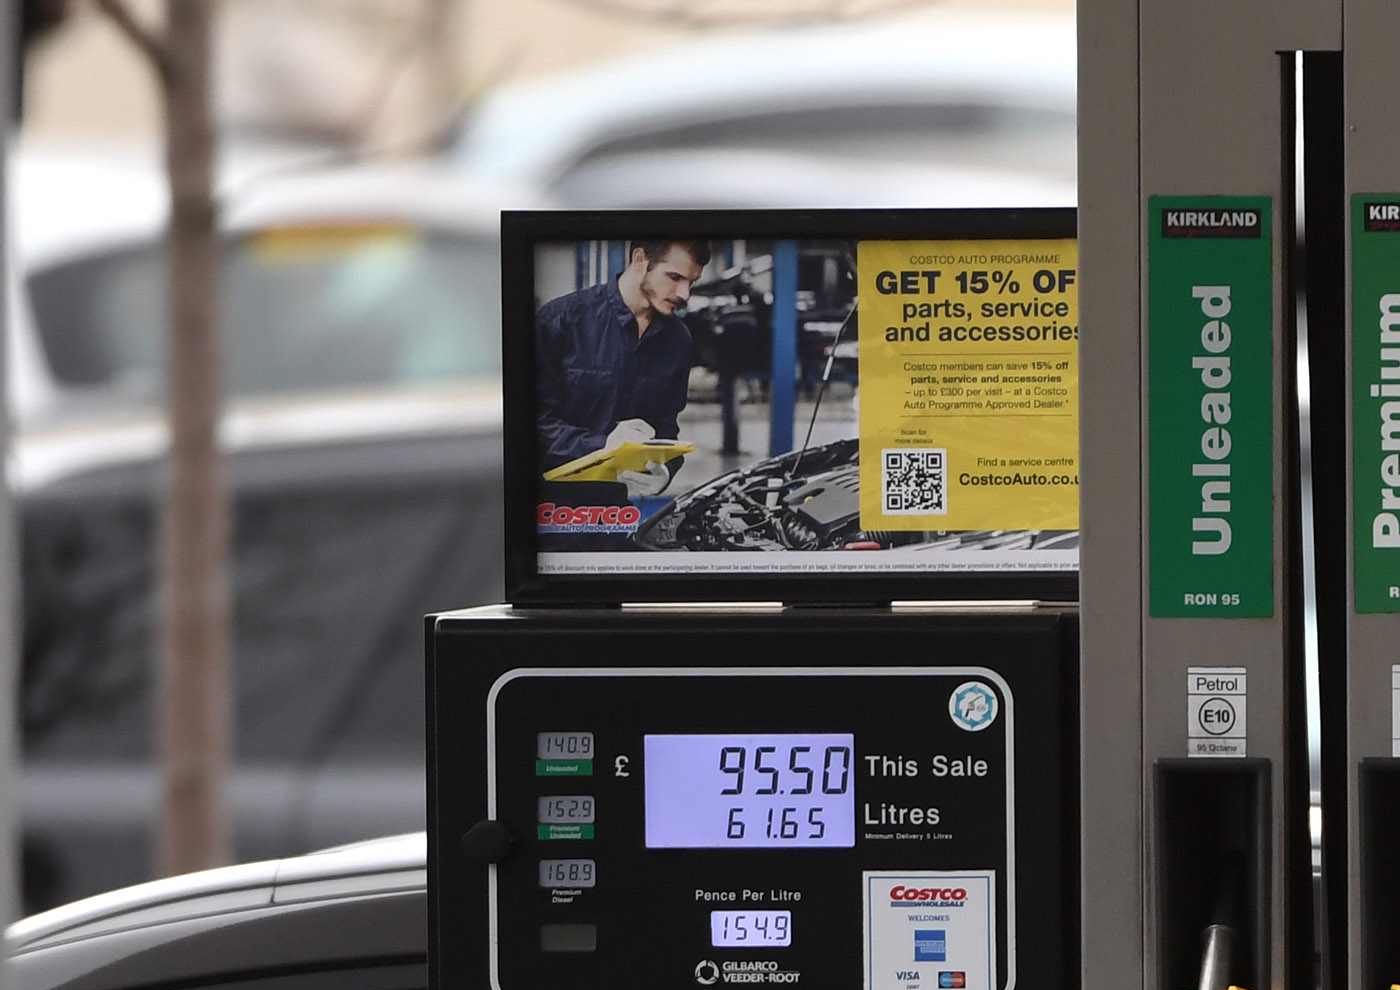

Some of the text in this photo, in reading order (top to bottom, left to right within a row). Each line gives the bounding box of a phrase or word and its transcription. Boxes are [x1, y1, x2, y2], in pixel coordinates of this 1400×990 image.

[1167, 212, 1257, 227] KIRKLAND
[910, 255, 1060, 265] COSTCO AUTO PROGRAMME
[876, 270, 1076, 295] GET 15% OF
[903, 298, 1069, 323] parts, service
[885, 322, 930, 342] and
[903, 362, 937, 371] Costco
[940, 362, 983, 371] members
[1031, 362, 1052, 371] 15%
[1056, 361, 1069, 370] off
[1192, 286, 1232, 555] Unleaded
[977, 458, 998, 467] Find
[1009, 458, 1042, 467] service
[1045, 459, 1074, 467] centre
[537, 503, 640, 525] COSTCO
[1184, 593, 1240, 605] RON 95
[1196, 677, 1238, 691] Petrol
[1204, 709, 1230, 723] E10
[547, 737, 591, 753] 140.9
[615, 755, 630, 777] £
[720, 747, 850, 795] 95.50
[864, 755, 988, 777] This Sale
[548, 801, 592, 817] 152.9
[865, 803, 940, 825] Litres
[727, 808, 825, 839] 61.65
[549, 864, 593, 881] 168.9
[695, 889, 802, 901] Pence Per Litre
[890, 886, 968, 900] COSTCO
[724, 916, 788, 940] 154.9
[722, 962, 778, 971] GILBARCO
[722, 973, 800, 983] VEEDER-ROOT
[896, 971, 920, 980] VISA
